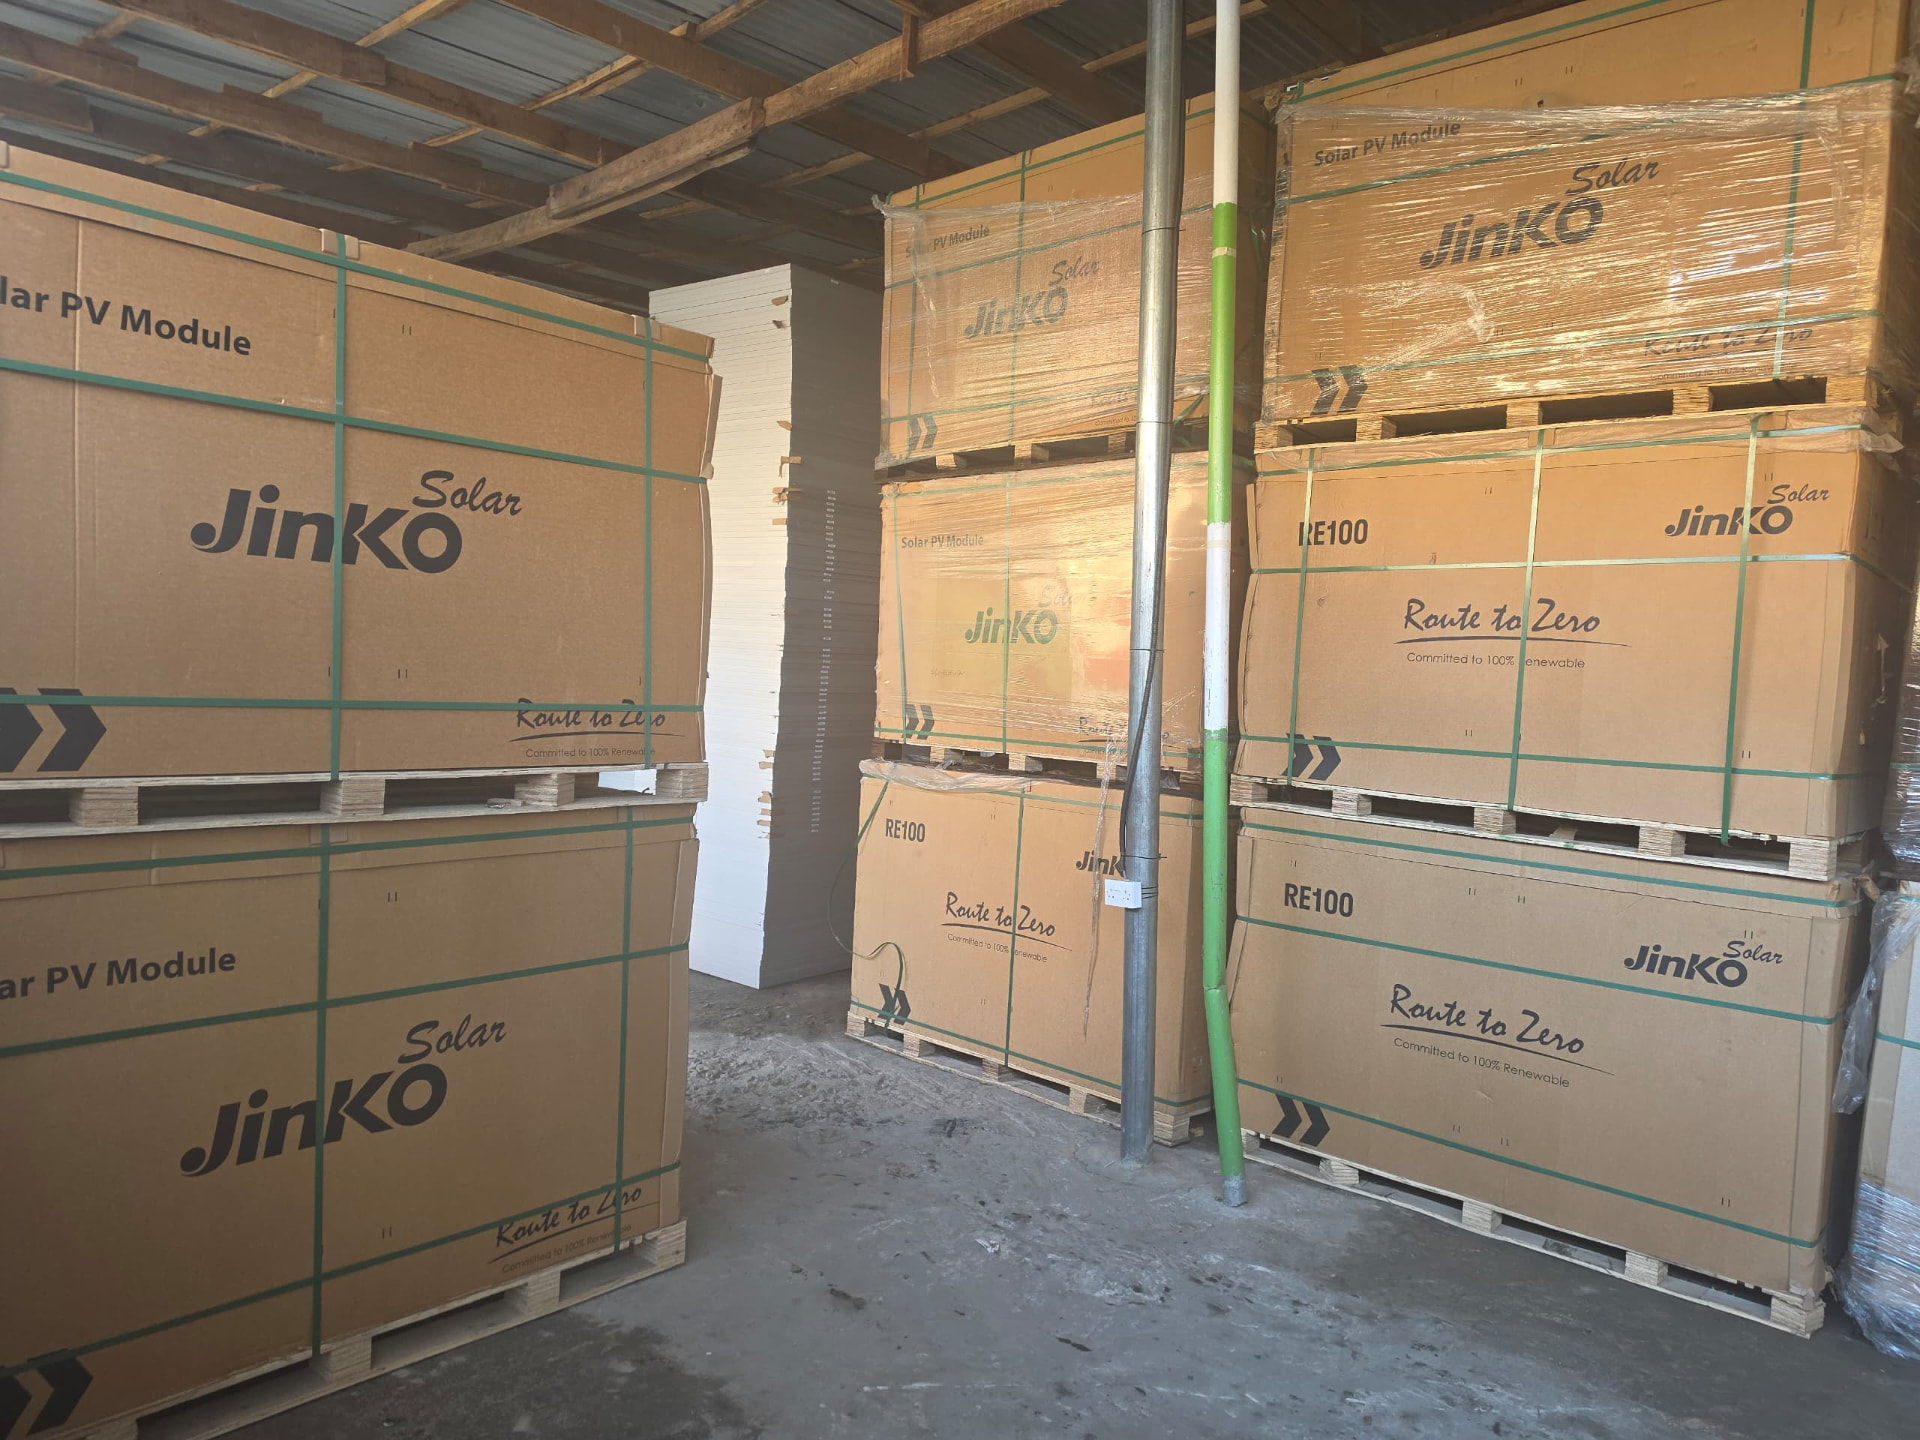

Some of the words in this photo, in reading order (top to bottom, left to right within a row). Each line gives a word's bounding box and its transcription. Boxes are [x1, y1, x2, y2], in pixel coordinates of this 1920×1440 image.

[1314, 146, 1358, 166] Solar
[1363, 136, 1386, 156] PV
[1391, 121, 1461, 149] Module
[1564, 157, 1660, 196] Solar
[933, 235, 948, 250] PV
[949, 224, 990, 246] Module
[1048, 256, 1100, 286] Solar
[61, 291, 110, 325] PV
[120, 304, 251, 355] Module
[412, 470, 522, 517] Solar
[1767, 483, 1830, 505] Solar
[901, 536, 929, 549] Solar
[931, 535, 944, 547] PV
[947, 533, 984, 547] Module
[1298, 518, 1368, 547] RE100
[1404, 598, 1480, 631] Route
[1490, 604, 1522, 632] to
[1531, 597, 1601, 633] Zero
[1406, 652, 1469, 665] Committed
[1471, 654, 1483, 665] to
[1487, 655, 1515, 666] 100%
[1524, 658, 1586, 669] enewable
[516, 698, 581, 728] Route
[525, 748, 575, 758] Committed
[611, 747, 656, 757] Renewae
[885, 818, 926, 843] RE100
[1075, 850, 1125, 878] JinK
[945, 891, 990, 922] Route
[995, 905, 1013, 927] to
[1017, 905, 1056, 937] Zero
[1284, 882, 1354, 917] RE100
[947, 933, 984, 948] Committed
[1014, 949, 1048, 963] enewable
[1722, 940, 1783, 964] Solar
[47, 962, 97, 994] PV
[106, 947, 236, 986] Module
[1390, 983, 1466, 1027] Route
[1476, 1008, 1507, 1036] to
[1515, 1009, 1585, 1054] Zero
[398, 1013, 507, 1064] Solar
[1393, 1037, 1455, 1060] Committed
[1458, 1052, 1470, 1063] to
[1473, 1055, 1501, 1071] 100%
[1503, 1063, 1570, 1088] Renewable
[496, 1209, 560, 1248] Route
[567, 1200, 591, 1225] to
